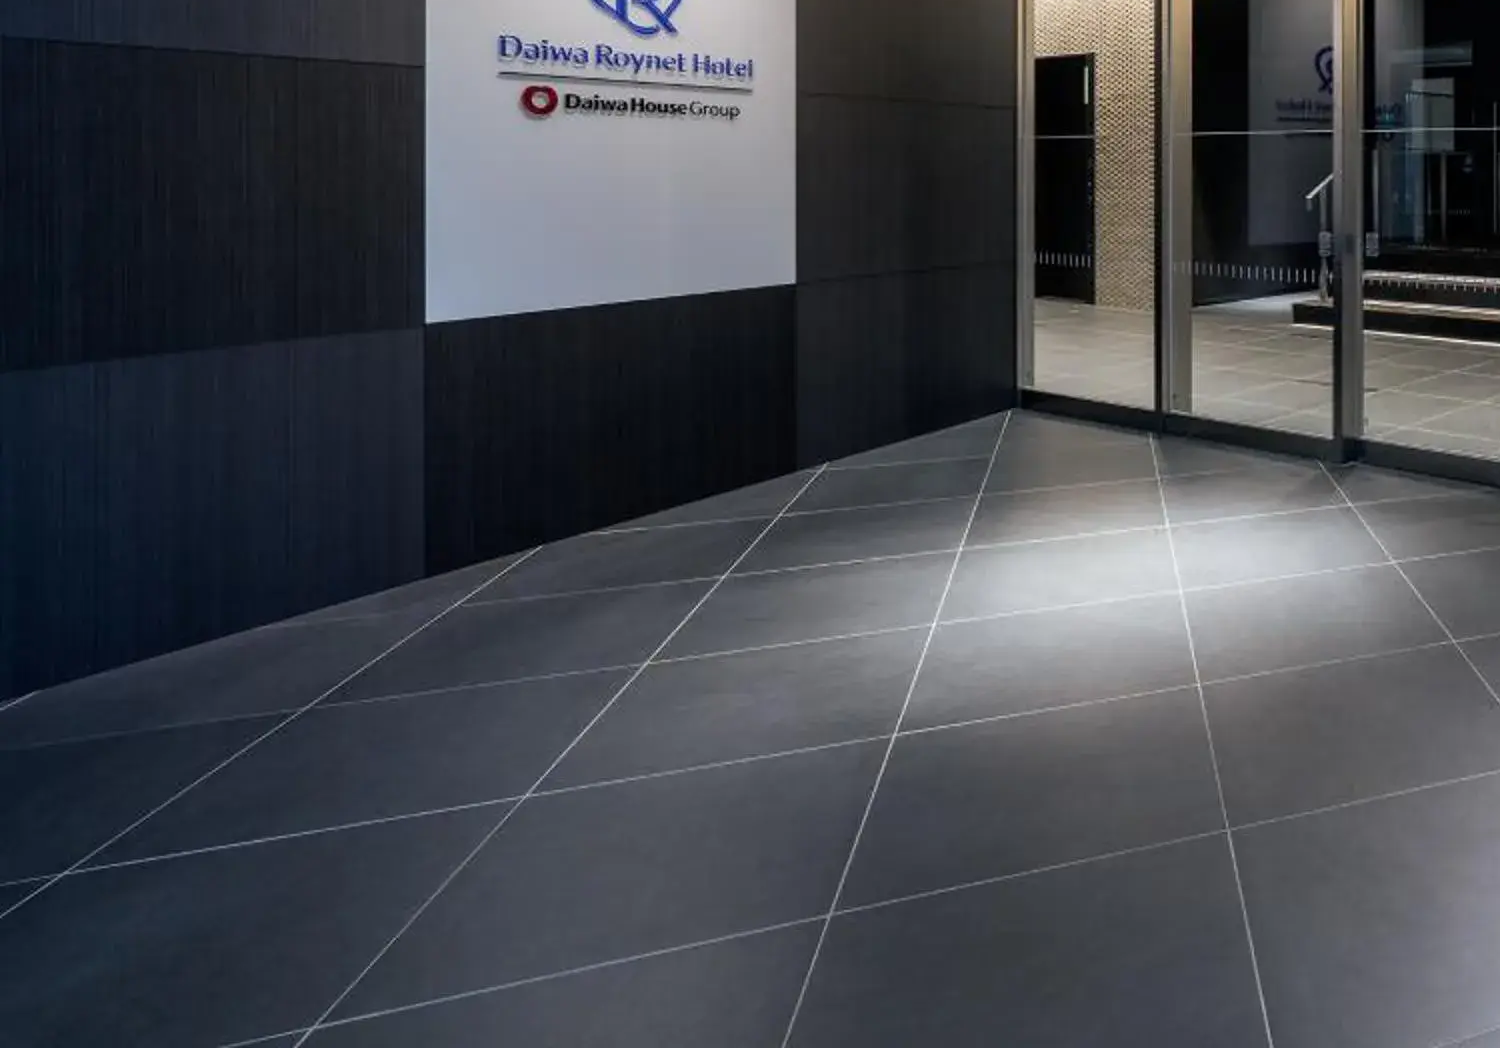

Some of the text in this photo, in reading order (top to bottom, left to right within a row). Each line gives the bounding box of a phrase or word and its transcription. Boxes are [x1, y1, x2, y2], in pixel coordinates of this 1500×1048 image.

[498, 34, 753, 78] Daiwa Roynet Hotel
[689, 100, 741, 120] Group
